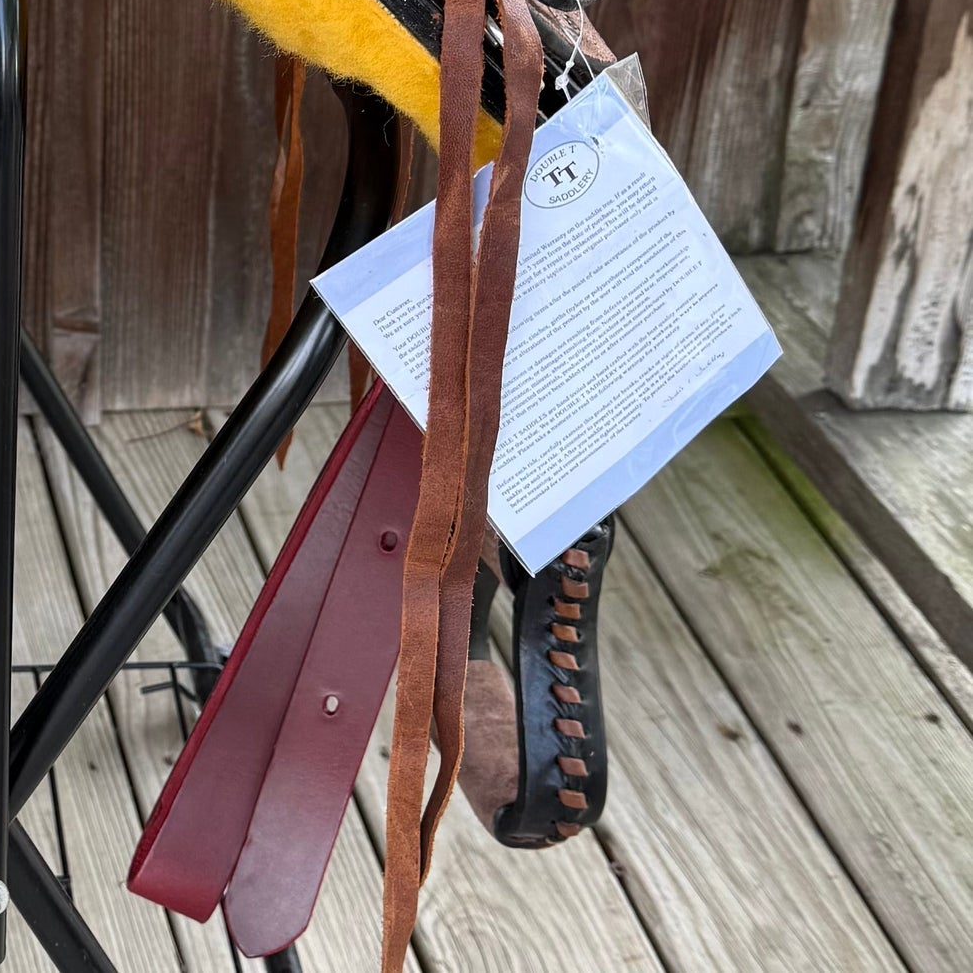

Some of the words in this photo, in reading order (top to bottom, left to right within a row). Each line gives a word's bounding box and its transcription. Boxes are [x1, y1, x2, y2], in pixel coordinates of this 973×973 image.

[528, 147, 567, 182] DOUBLE
[567, 143, 576, 153] T
[541, 160, 579, 187] TT
[549, 167, 594, 203] SADDLERY
